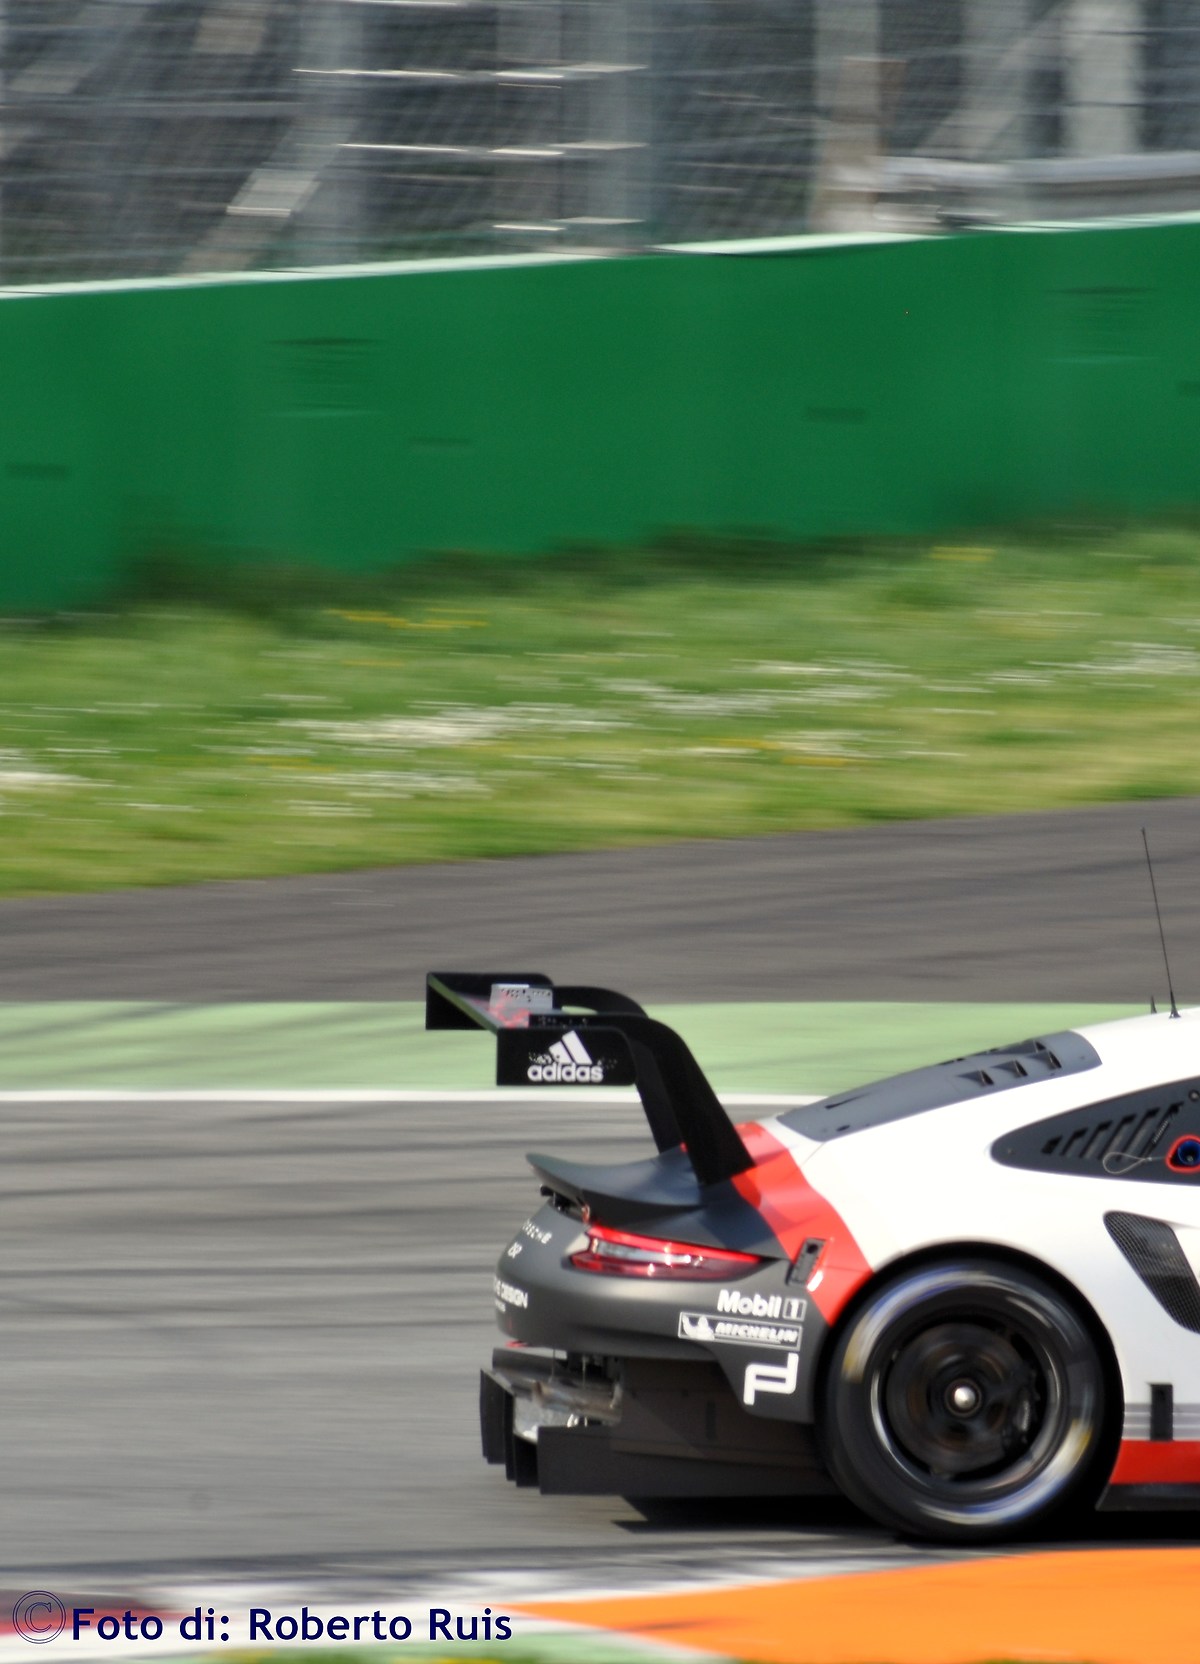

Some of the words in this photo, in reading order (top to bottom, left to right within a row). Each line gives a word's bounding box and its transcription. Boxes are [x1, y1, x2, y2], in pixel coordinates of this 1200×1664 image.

[527, 1062, 604, 1083] adidas
[717, 1289, 782, 1319] Mobil
[715, 1322, 799, 1343] MICHELIN
